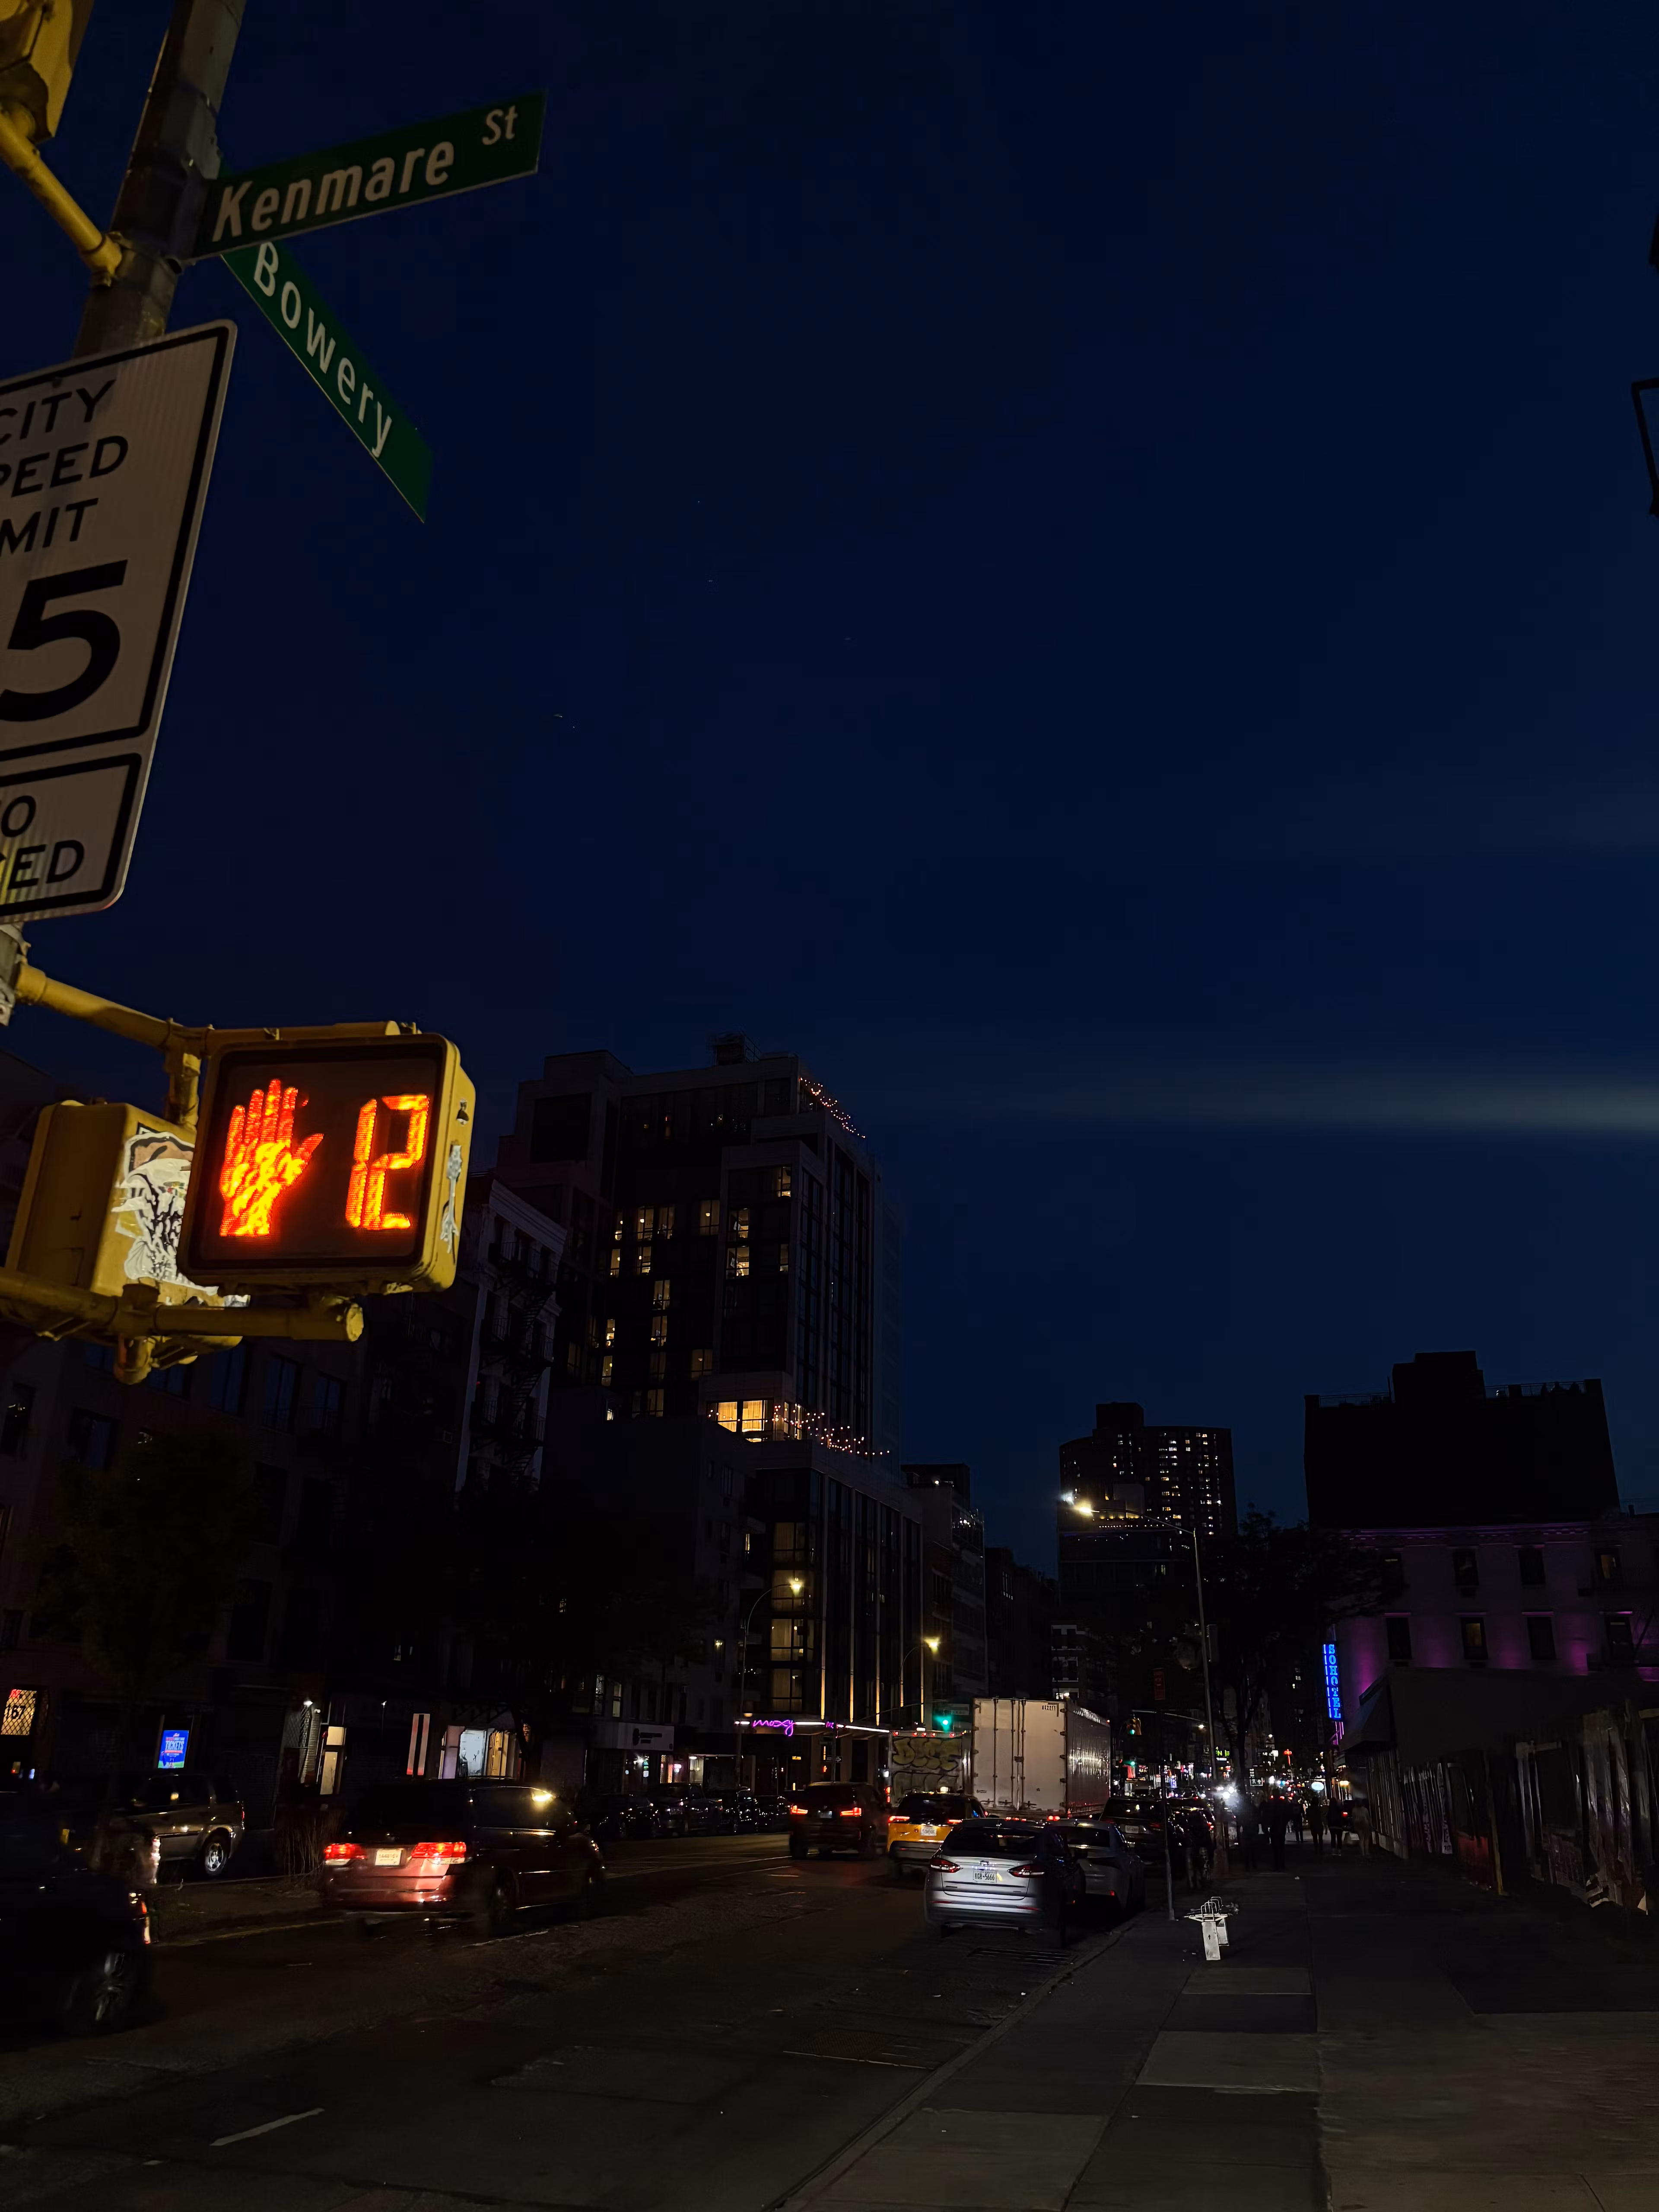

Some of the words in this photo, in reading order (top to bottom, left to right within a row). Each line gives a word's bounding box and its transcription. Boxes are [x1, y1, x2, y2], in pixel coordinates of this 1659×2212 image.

[211, 140, 455, 243] Kenmare
[481, 105, 518, 146] St
[254, 242, 392, 458] Bowery
[0, 559, 128, 721] 5
[0, 840, 84, 890] ED
[345, 1093, 430, 1230] 12
[165, 1740, 184, 1750] TICKETS
[753, 1719, 794, 1737] moxy
